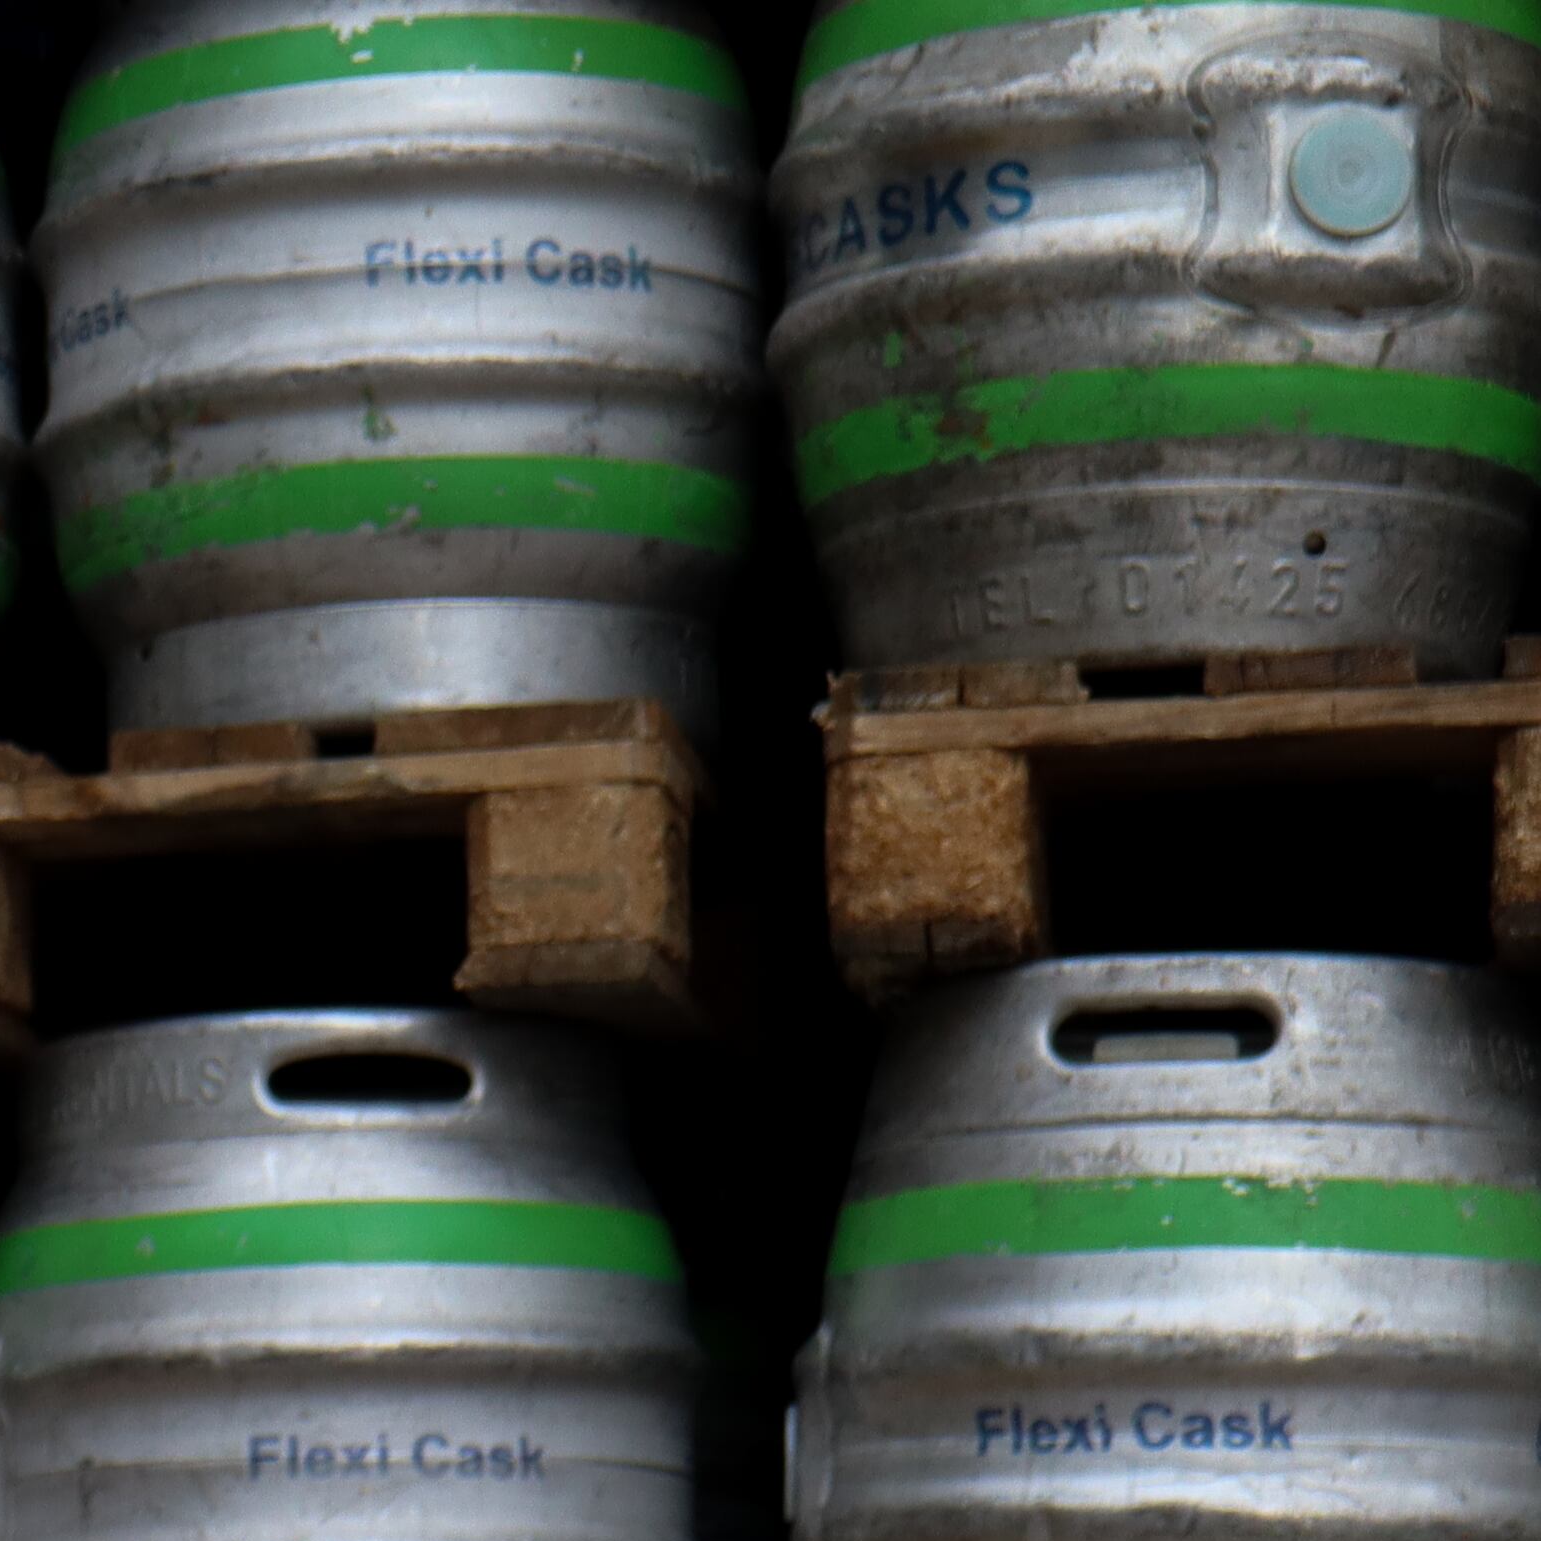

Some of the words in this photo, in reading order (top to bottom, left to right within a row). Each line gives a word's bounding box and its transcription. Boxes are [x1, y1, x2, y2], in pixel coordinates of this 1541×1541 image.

[804, 159, 1033, 272] CASKS
[364, 234, 506, 288] Flexi
[525, 234, 653, 292] Cask
[1121, 556, 1351, 620] 01425
[247, 1433, 390, 1481] Flexi
[412, 1432, 547, 1480] Cask
[974, 1400, 1112, 1457] Flexi
[1131, 1400, 1293, 1450] Cask
